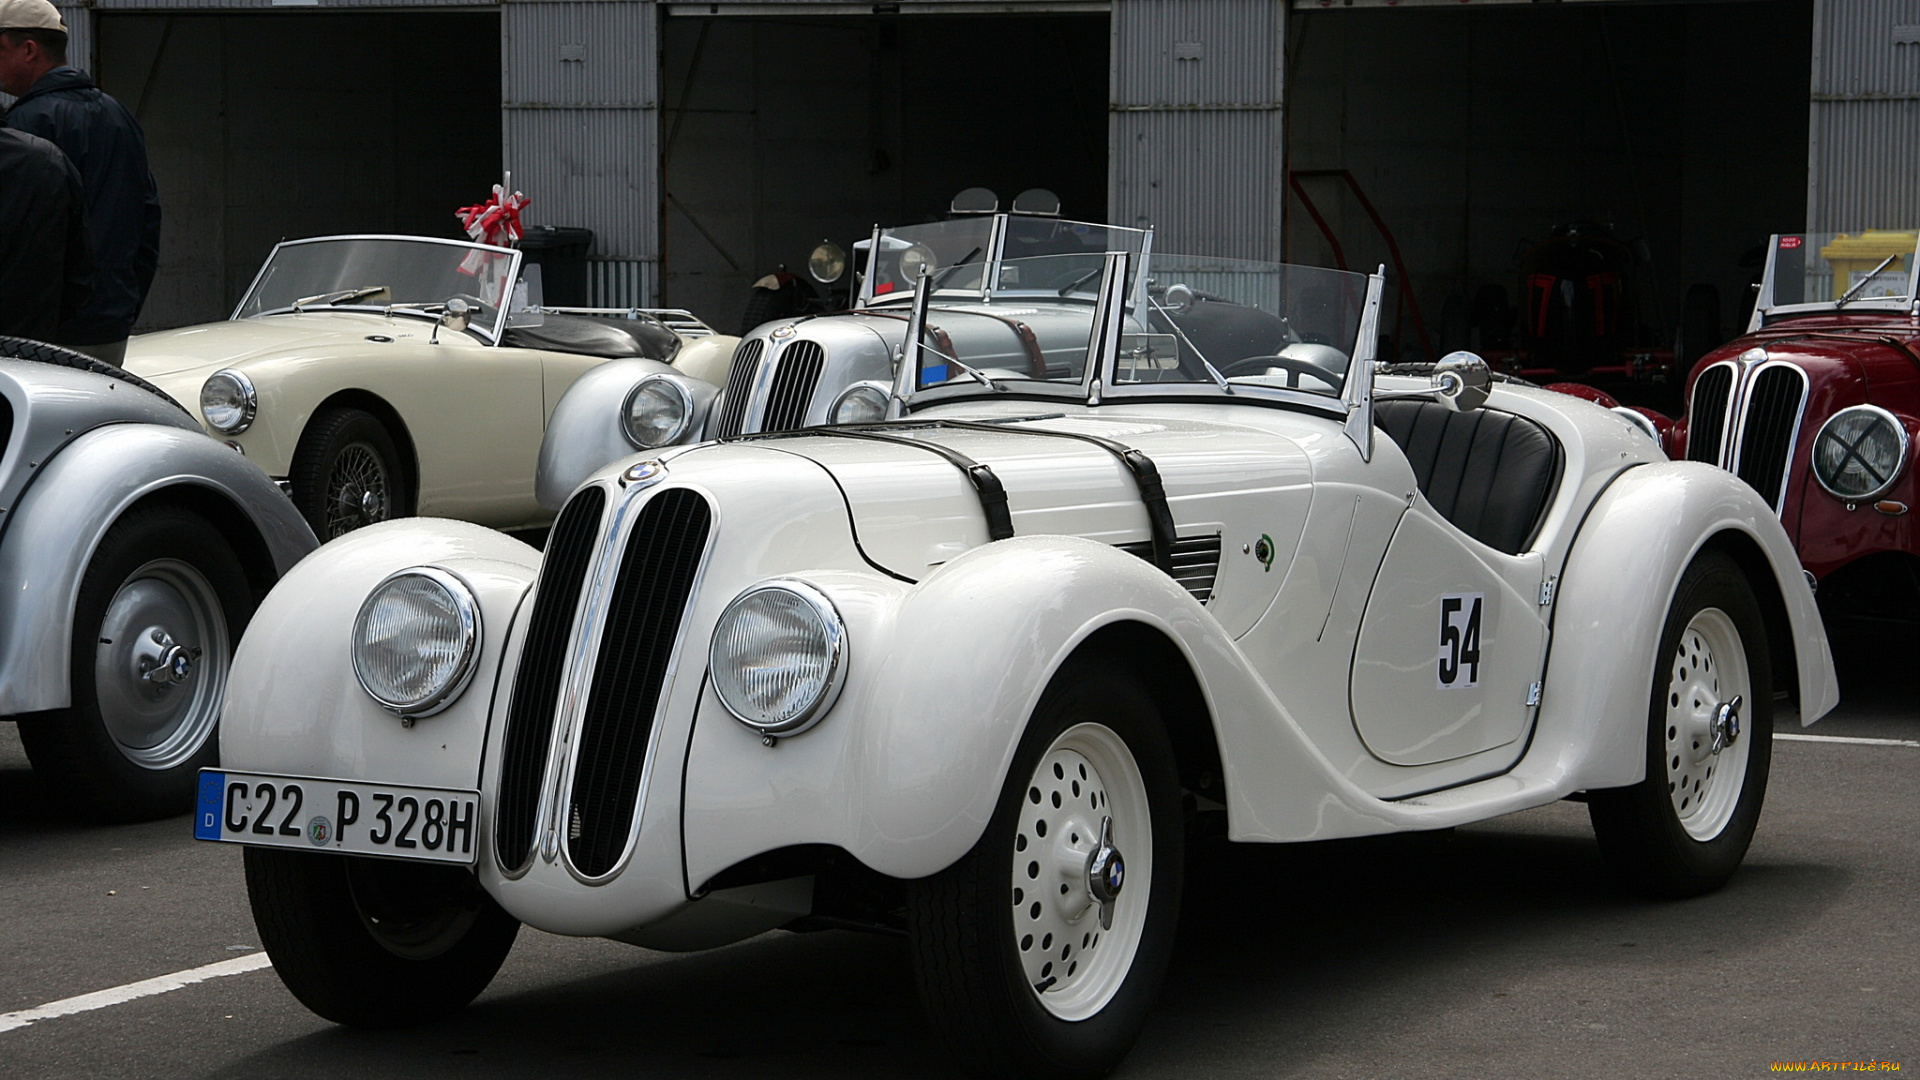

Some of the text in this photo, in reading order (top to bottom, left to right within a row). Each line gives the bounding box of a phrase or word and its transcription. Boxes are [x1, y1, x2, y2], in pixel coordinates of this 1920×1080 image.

[1439, 598, 1482, 684] 54
[204, 813, 214, 828] D
[225, 782, 474, 853] C22 P 328H
